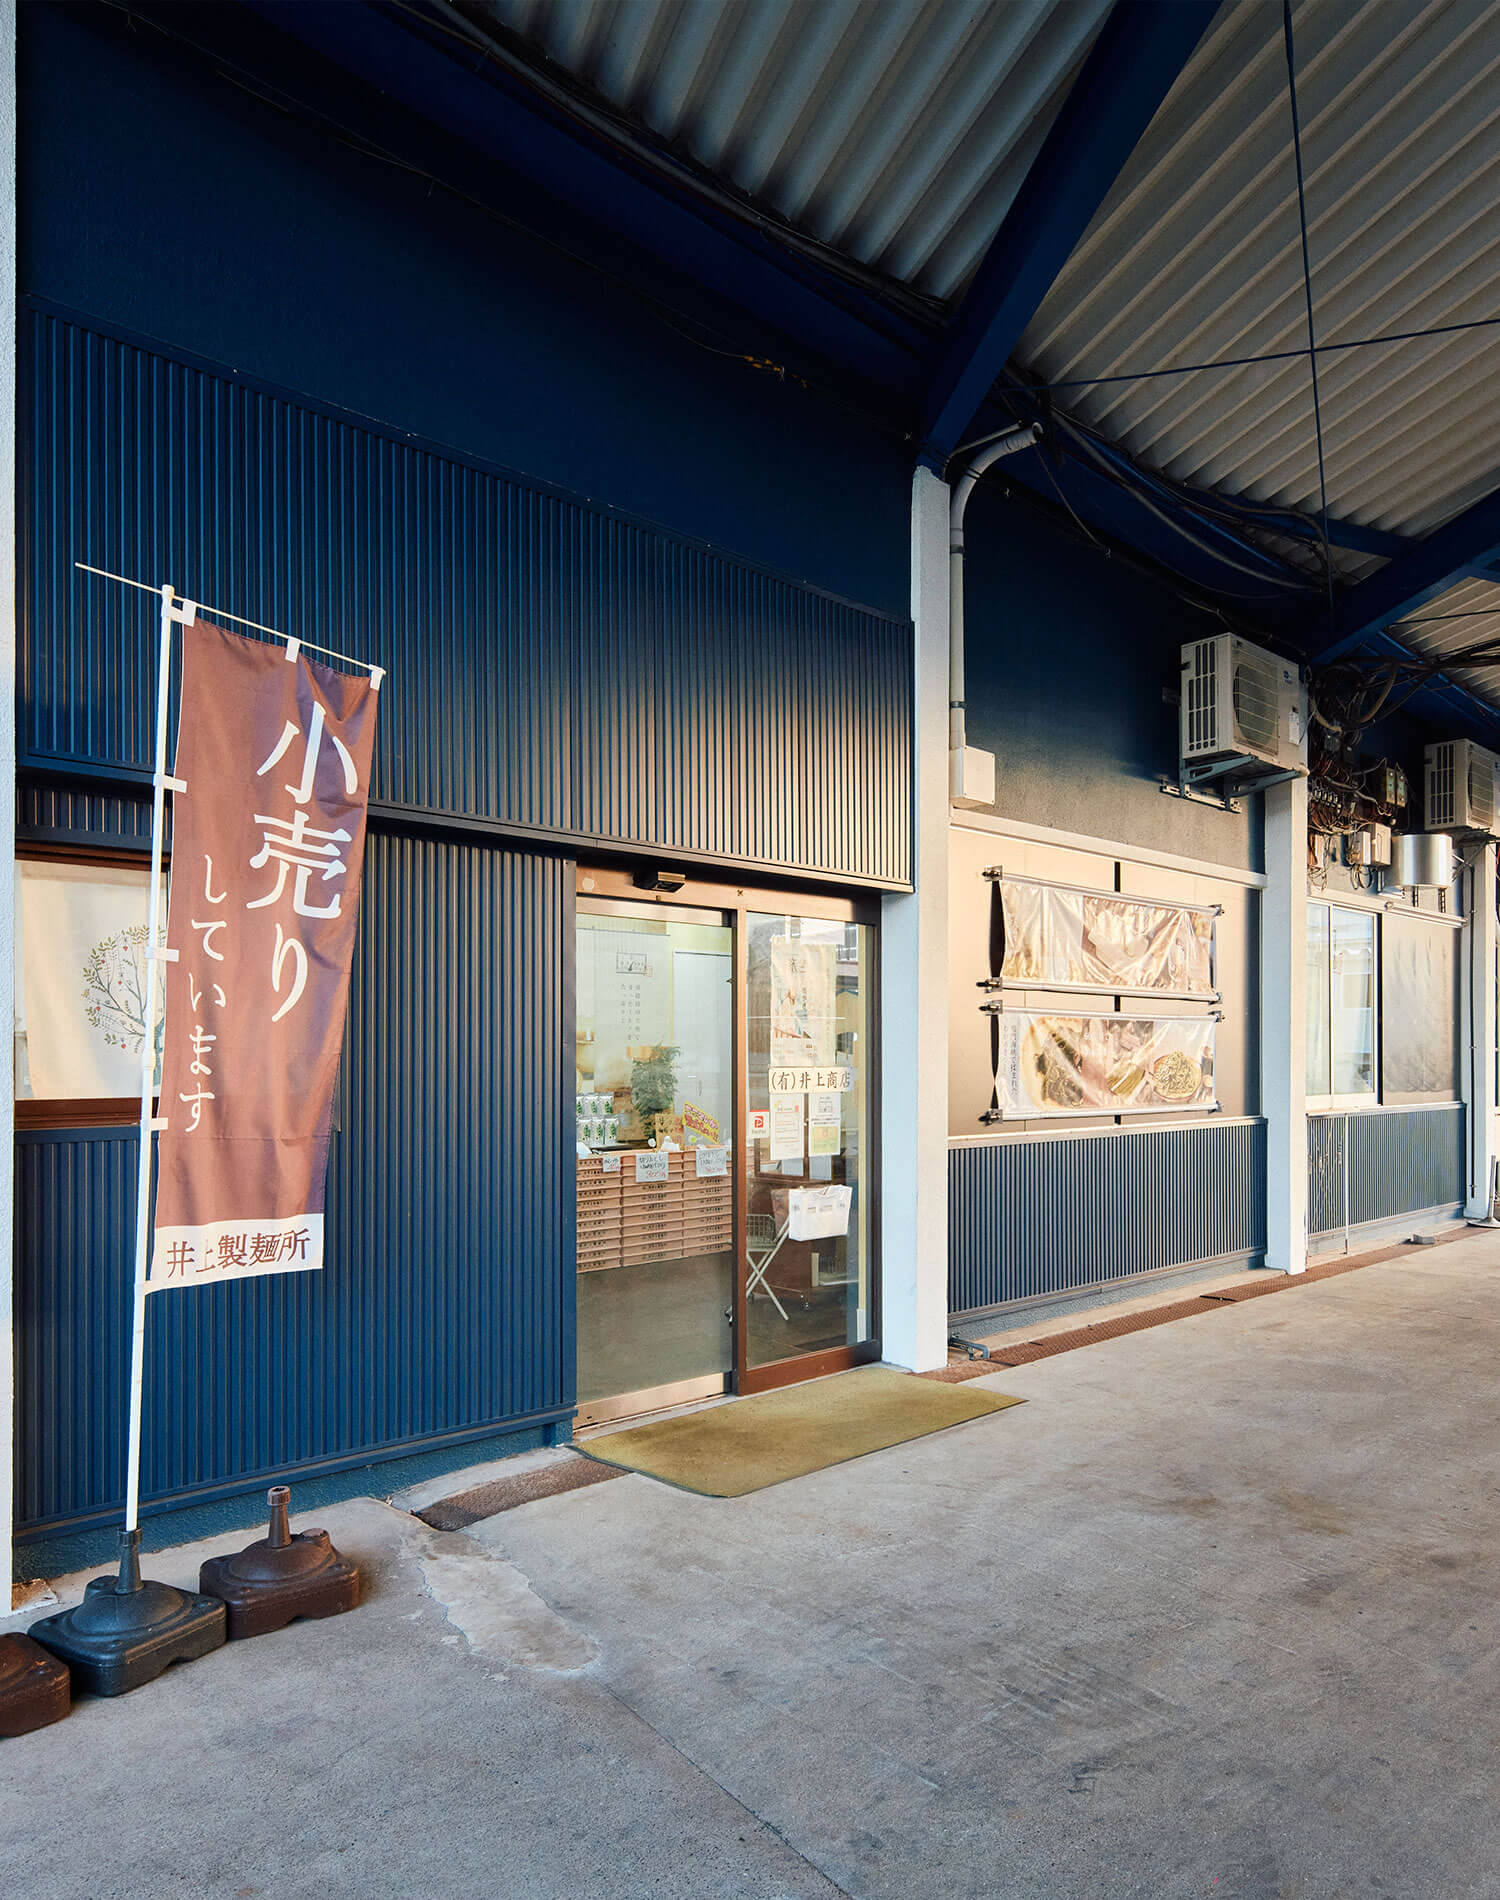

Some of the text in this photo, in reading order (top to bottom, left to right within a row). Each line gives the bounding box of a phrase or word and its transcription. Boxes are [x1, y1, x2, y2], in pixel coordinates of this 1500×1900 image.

[179, 854, 227, 1133] しています
[246, 701, 358, 1023] 小売り
[166, 1228, 310, 1279] 井上製麺所
